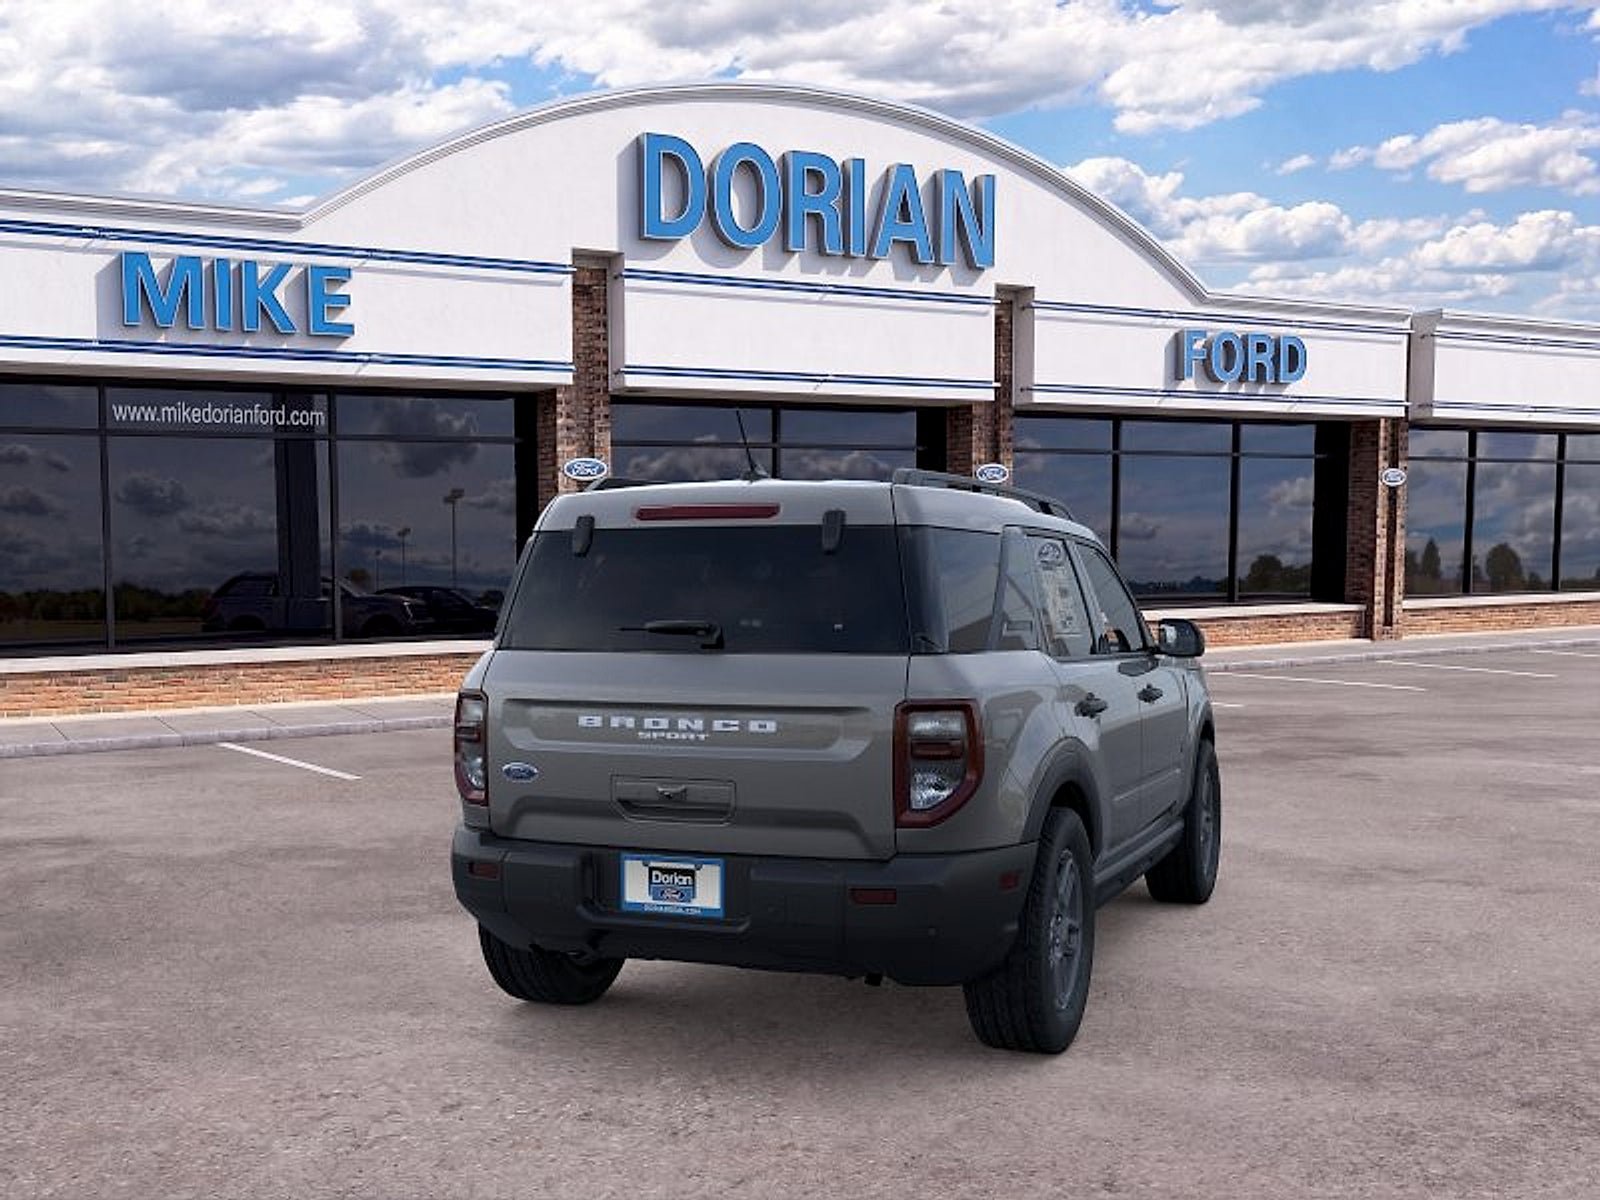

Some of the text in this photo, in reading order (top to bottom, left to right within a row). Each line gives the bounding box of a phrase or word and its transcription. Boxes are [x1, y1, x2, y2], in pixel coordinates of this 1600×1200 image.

[640, 132, 996, 270] DORIAN
[121, 251, 355, 338] MIKE
[1182, 328, 1308, 384] FORD
[112, 402, 326, 426] www.mikedorianford.com
[578, 715, 778, 733] BRONCO
[638, 731, 708, 741] SPORT
[651, 870, 693, 885] Dorian
